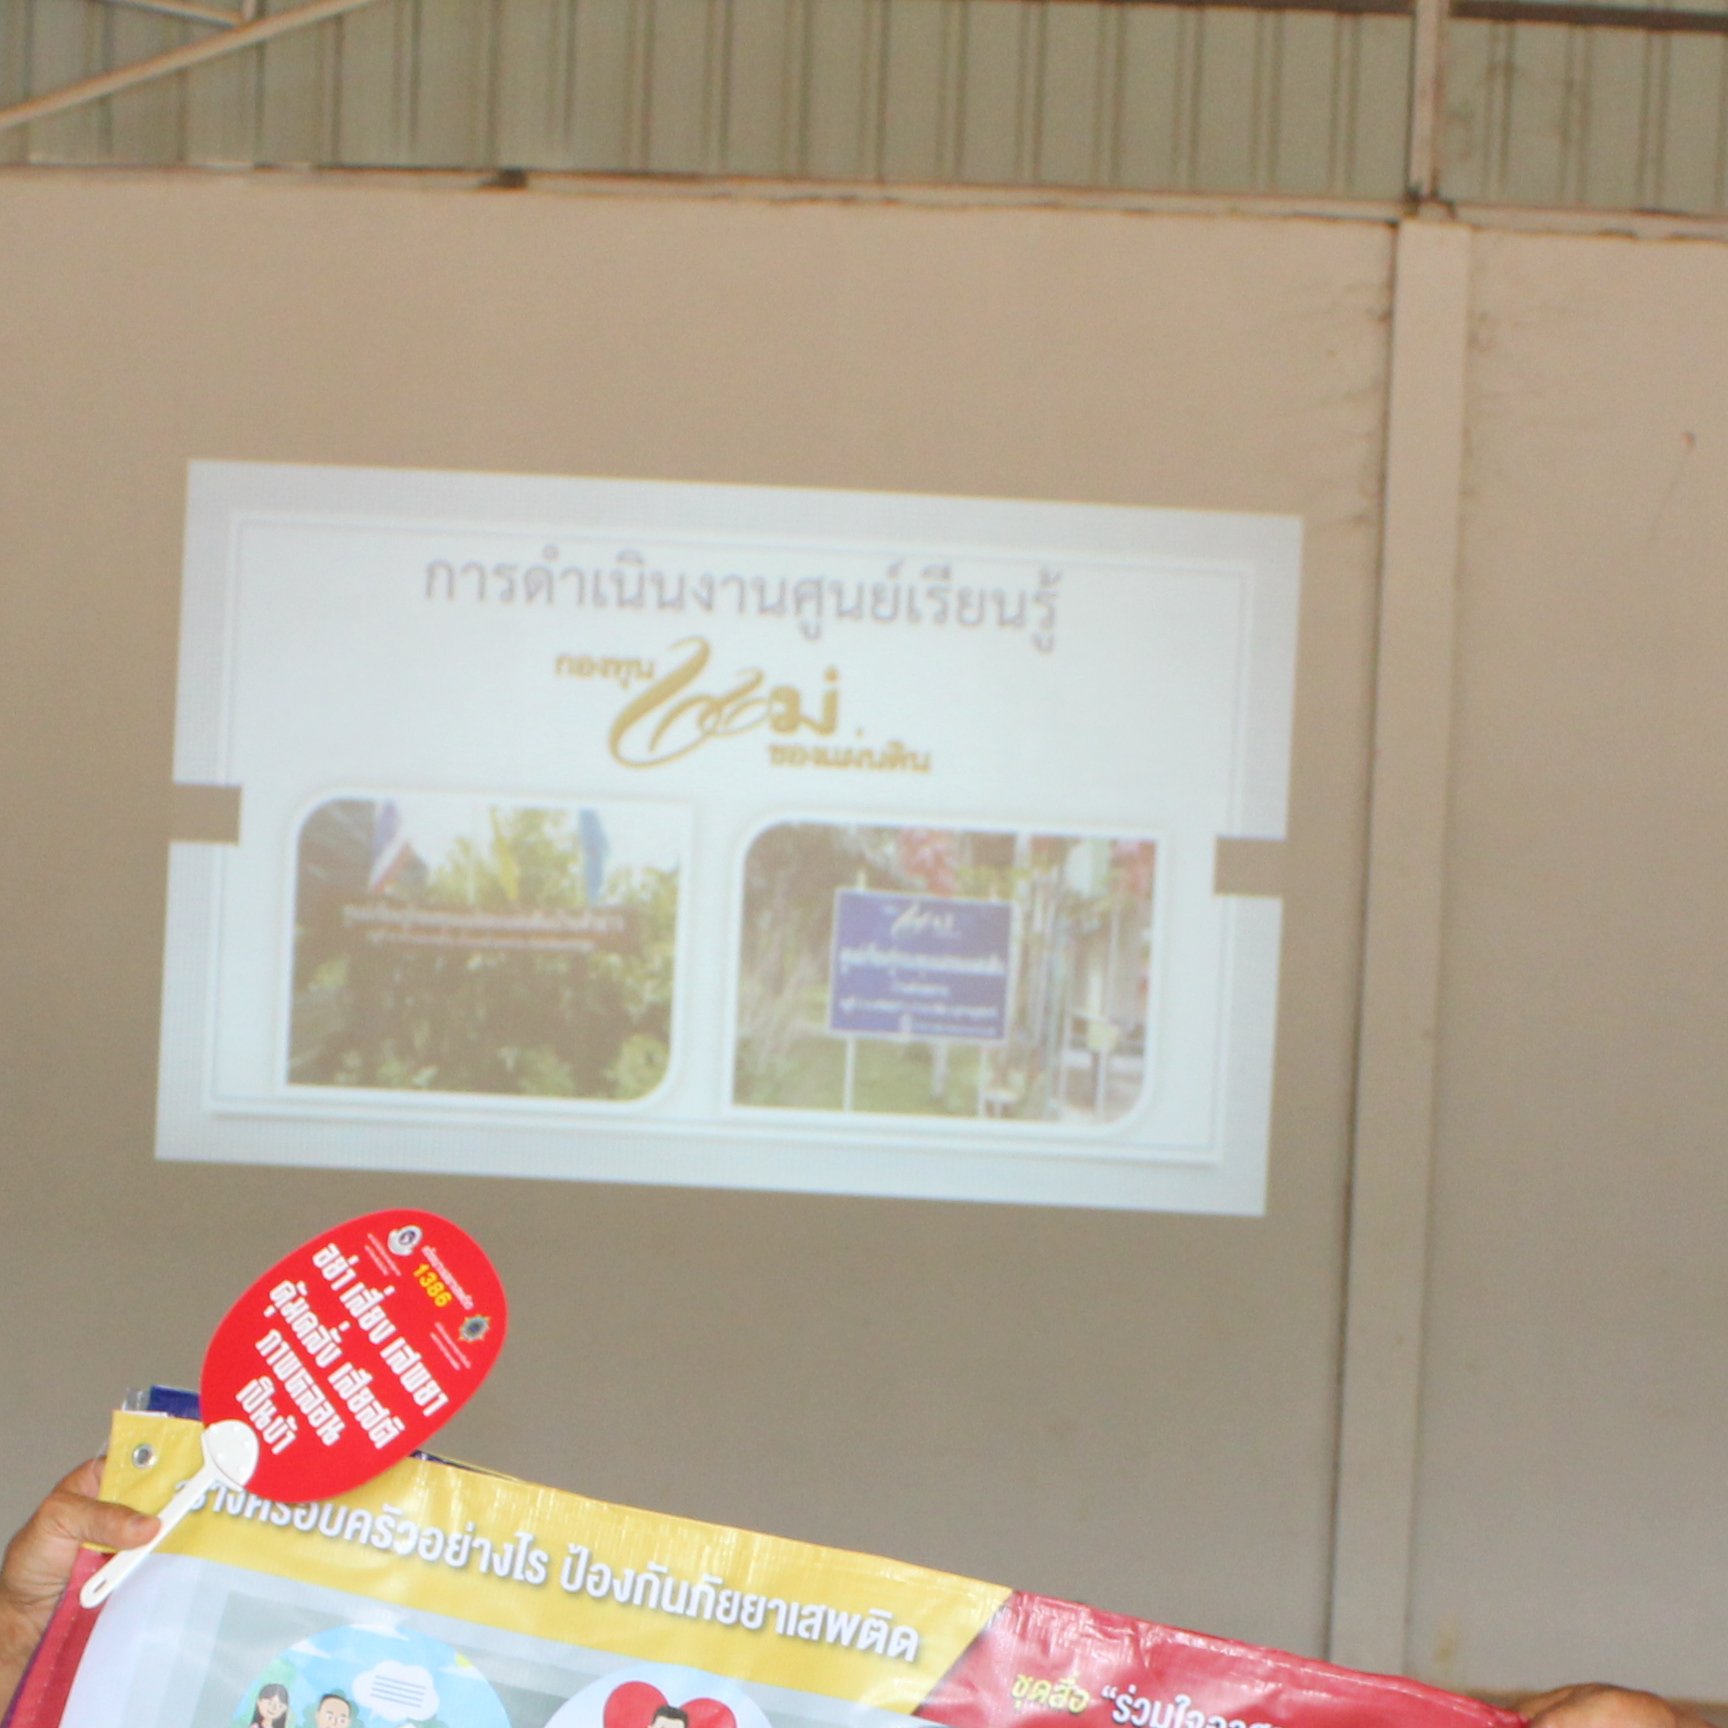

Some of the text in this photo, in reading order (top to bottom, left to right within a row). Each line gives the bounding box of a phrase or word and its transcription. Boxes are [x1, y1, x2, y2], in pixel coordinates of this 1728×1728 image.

[424, 545, 1063, 654] การดำเนินงานศูนย์เรียนรู้
[312, 1243, 359, 1291] อย่า
[339, 1281, 396, 1345] เสี่ยง
[380, 1337, 449, 1417] เสพยา
[413, 1263, 453, 1308] 1386
[235, 1376, 298, 1455] เป็นบ้า
[255, 1329, 346, 1447] ภาพหลอน
[328, 1361, 405, 1450] เสียสติ
[559, 1543, 921, 1663] ป้องกันภัยยาเสพติด
